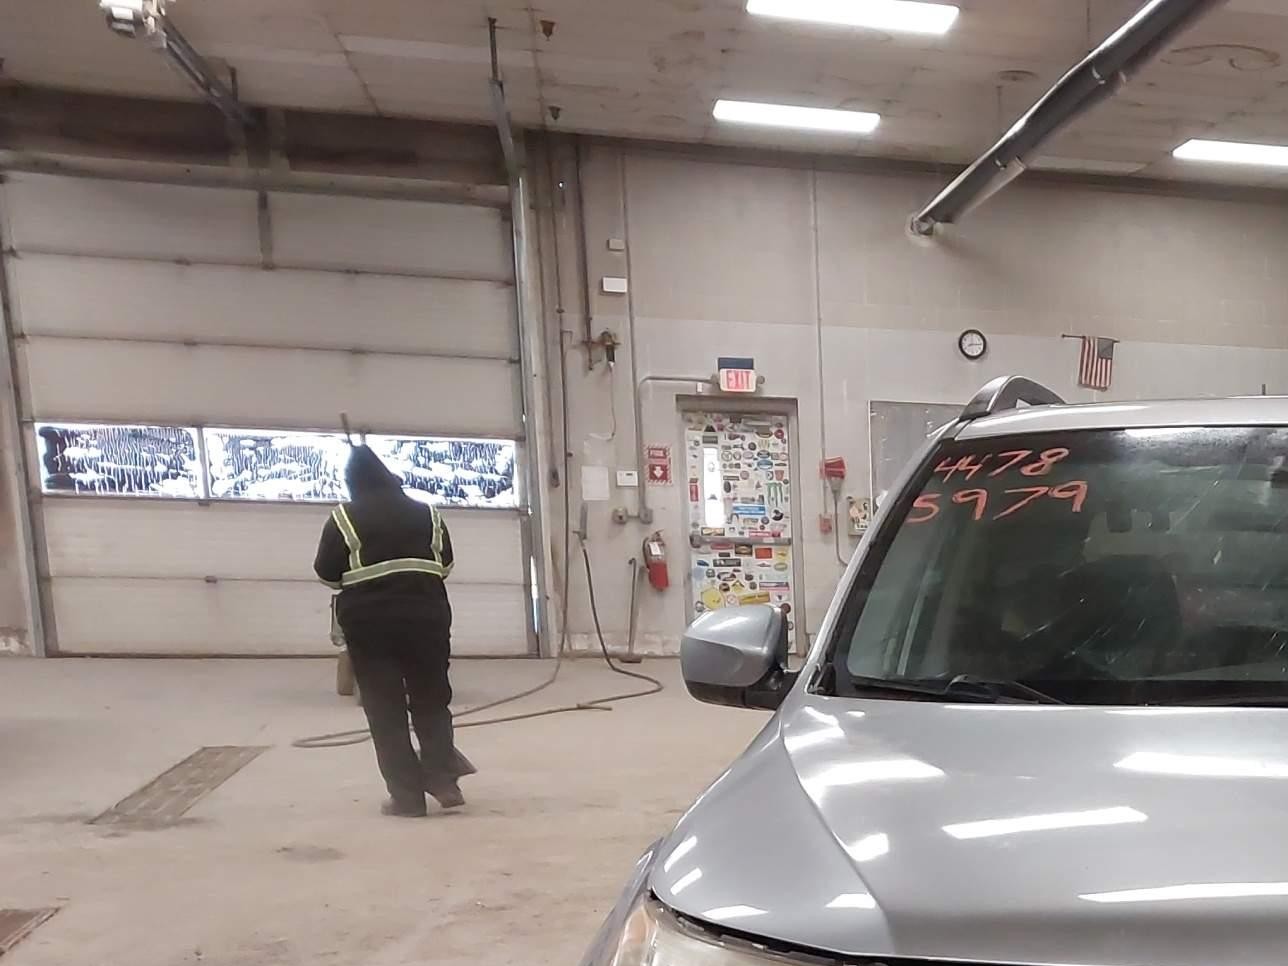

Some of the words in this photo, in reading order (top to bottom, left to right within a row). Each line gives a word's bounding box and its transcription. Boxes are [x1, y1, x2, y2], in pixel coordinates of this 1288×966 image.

[726, 369, 752, 390] EXIT
[933, 447, 1070, 484] 4478
[905, 480, 1089, 524] 5979
